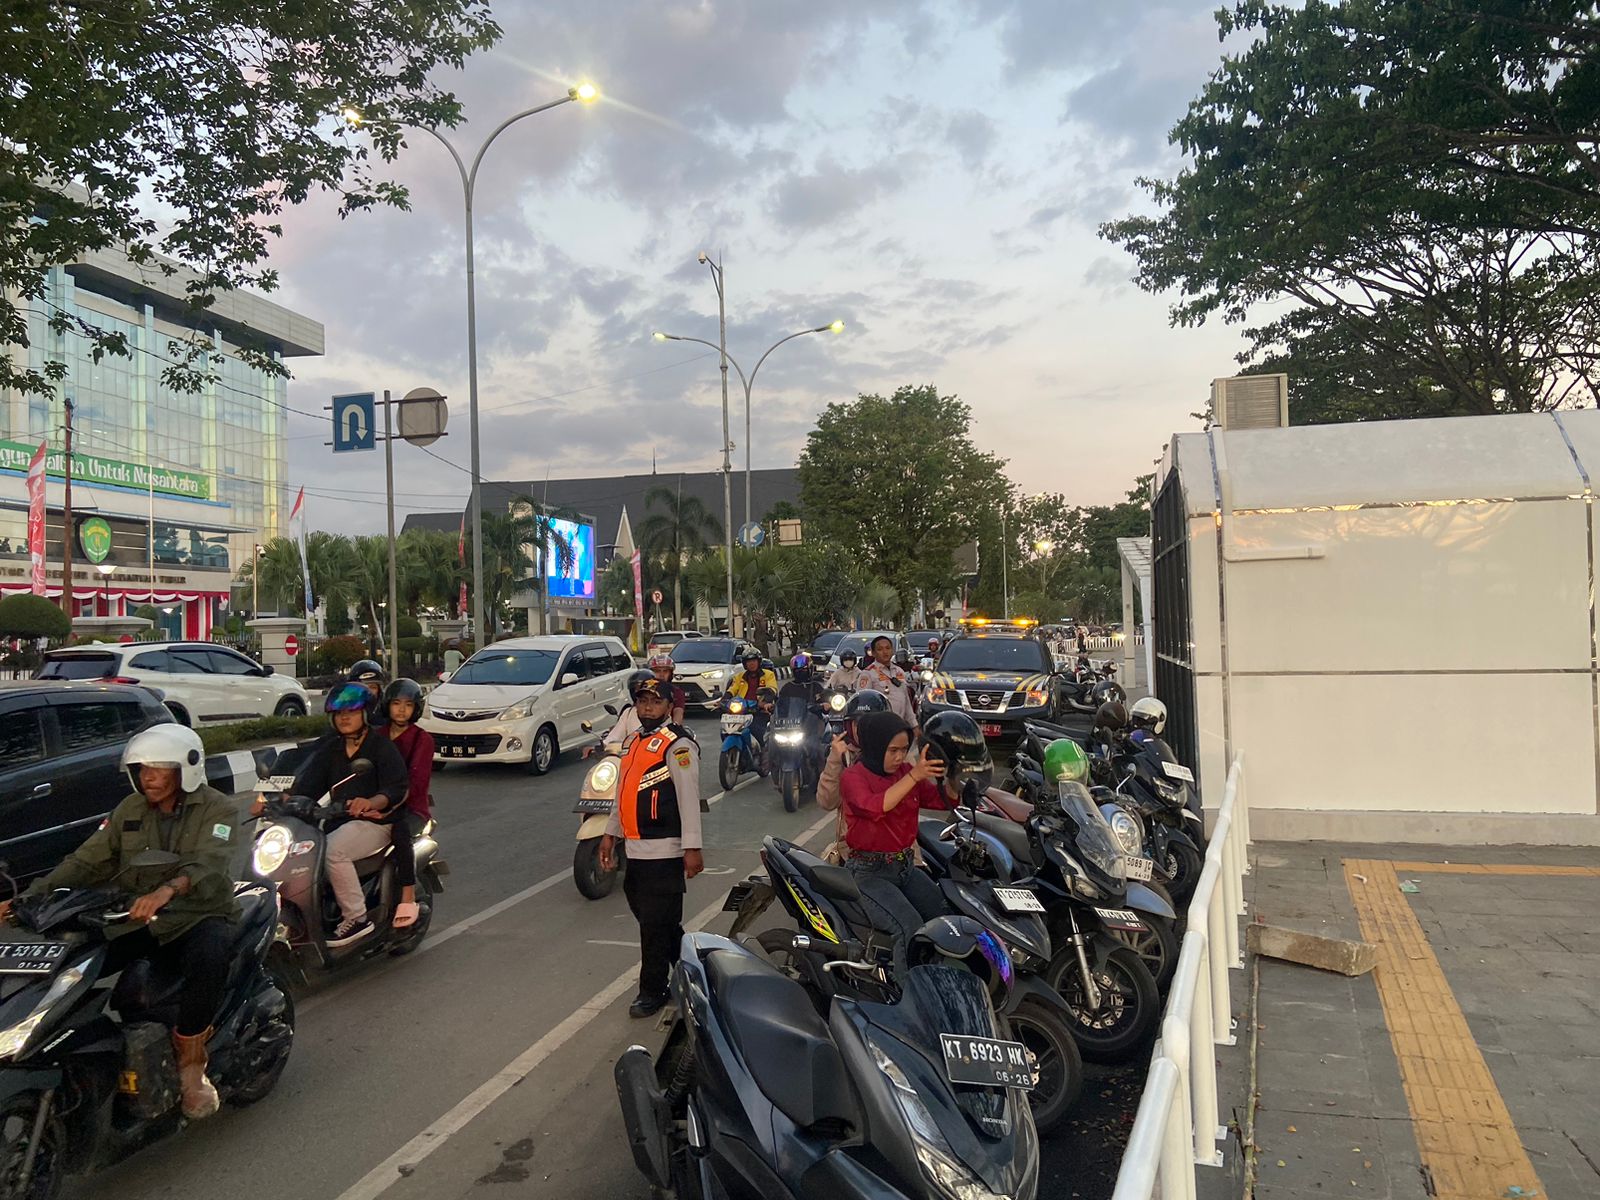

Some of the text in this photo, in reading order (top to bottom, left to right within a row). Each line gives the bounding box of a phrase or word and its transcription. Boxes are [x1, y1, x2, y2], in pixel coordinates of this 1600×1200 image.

[88, 458, 130, 483] Untuk
[133, 466, 198, 492] Nusantara
[1127, 857, 1142, 869] 5089
[12, 945, 45, 957] 5376
[944, 1039, 962, 1059] KT
[969, 1042, 1003, 1063] 6923
[982, 1117, 1008, 1125] HONDA
